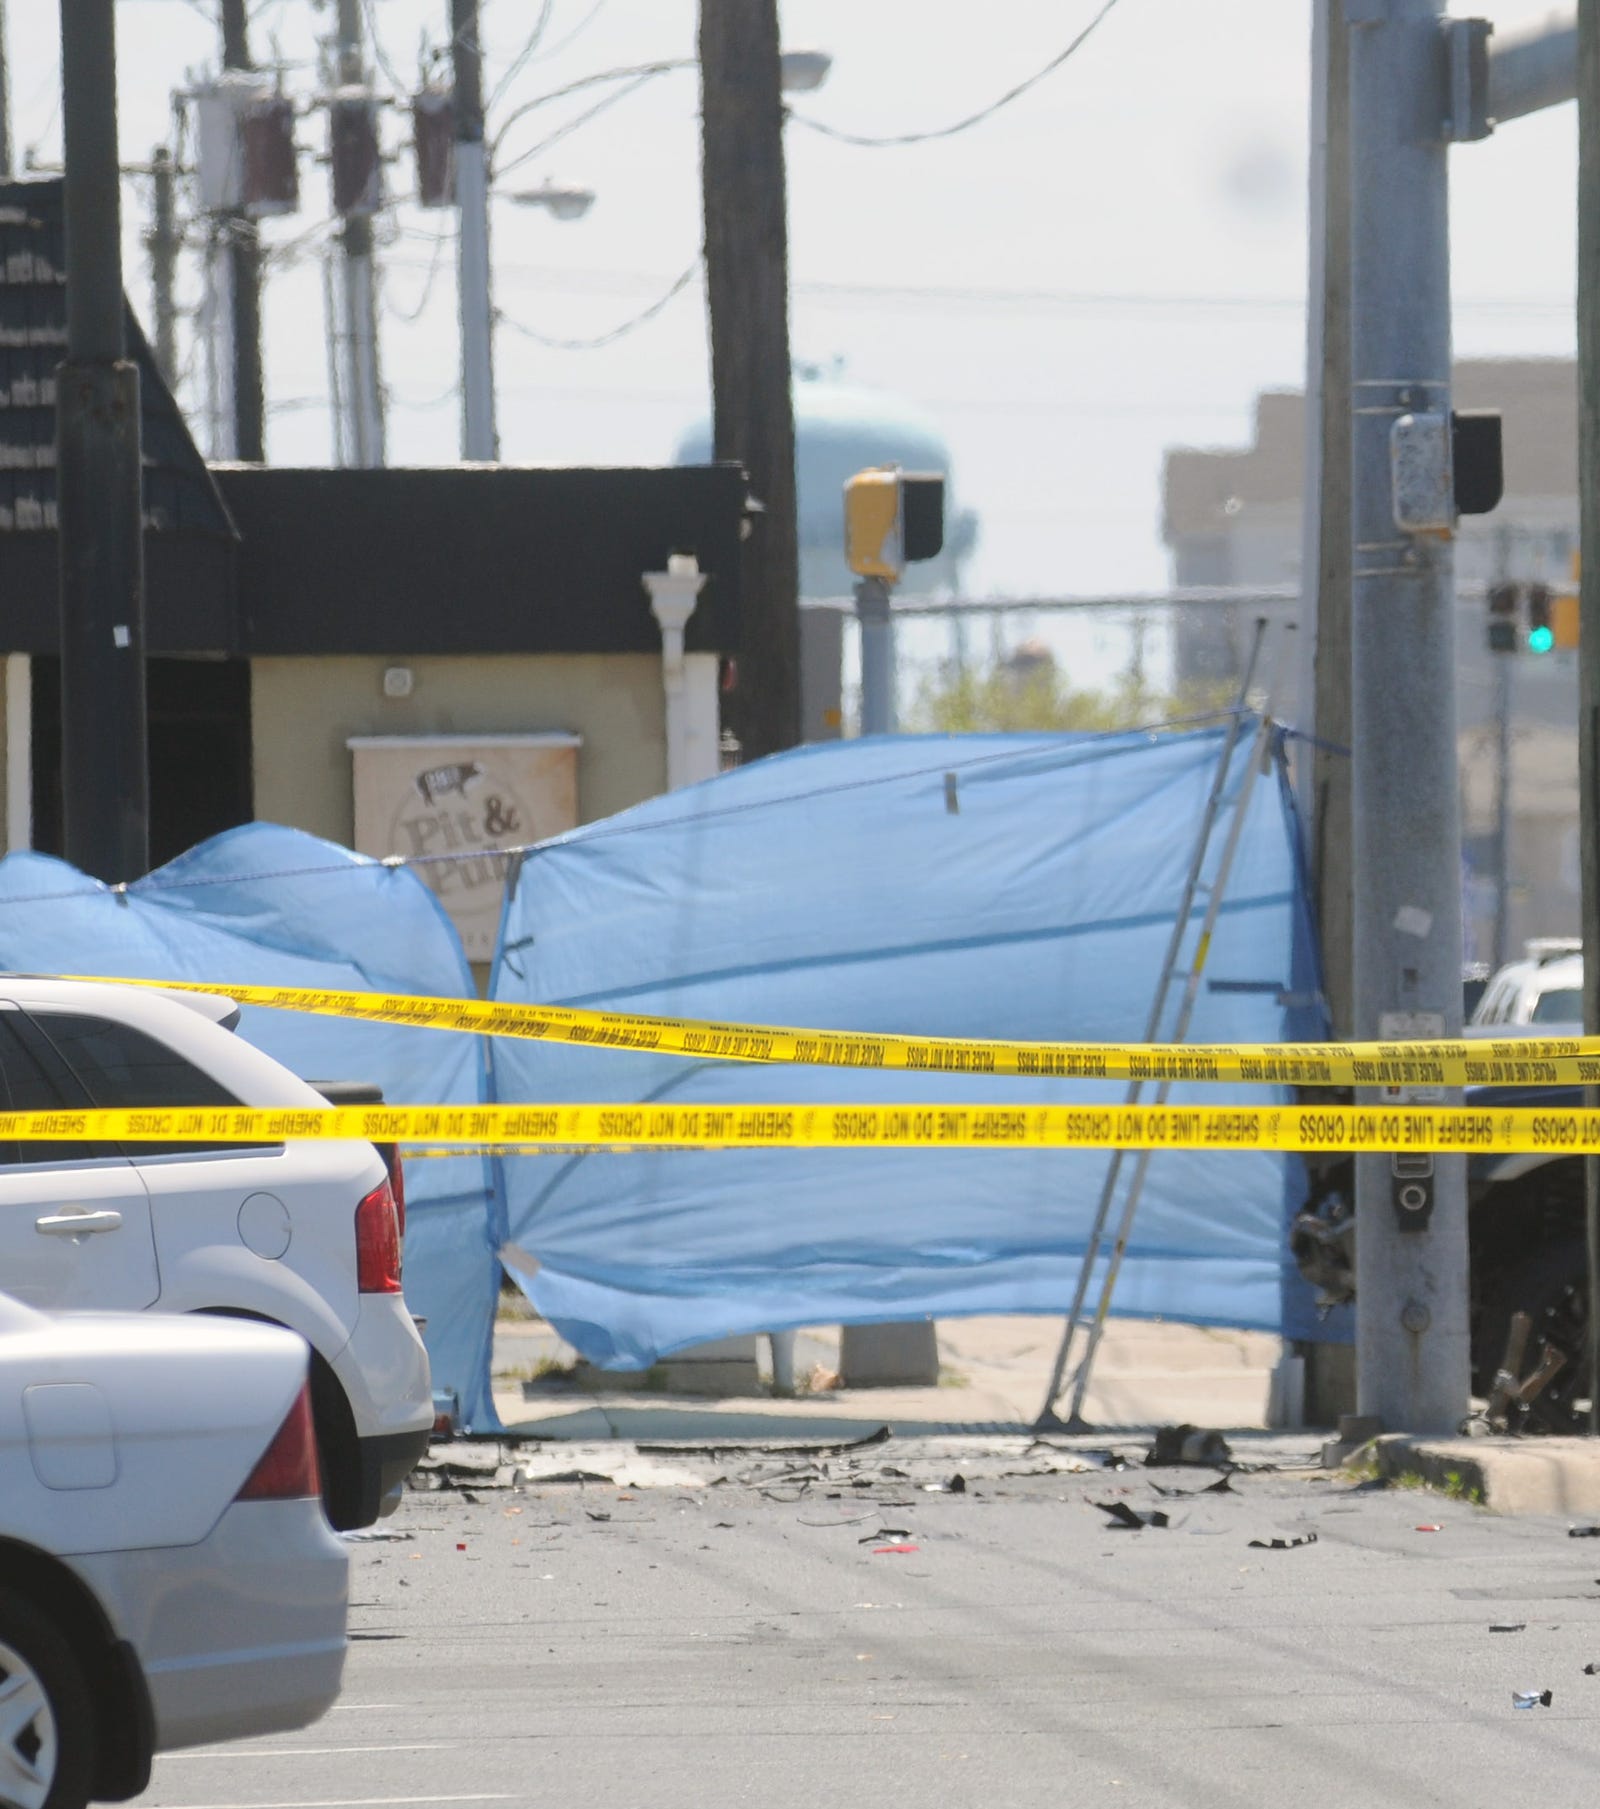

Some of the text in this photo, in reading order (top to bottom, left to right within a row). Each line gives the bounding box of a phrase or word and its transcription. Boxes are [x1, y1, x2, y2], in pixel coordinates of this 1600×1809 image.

[402, 795, 520, 857] Pit &
[1017, 1051, 1039, 1074] CROSS
[1066, 1053, 1082, 1076] LINE
[1129, 1055, 1151, 1078] CROSS
[1178, 1057, 1194, 1080] LINE
[1353, 1061, 1444, 1082] POLICE LINE DO NOT CROSS
[1066, 1113, 1259, 1141] SHERIFF LINE DO NOT CROSS
[1299, 1114, 1493, 1144] SHERIFF LINE DO NOT CROSS
[1532, 1116, 1577, 1146] CROSS
